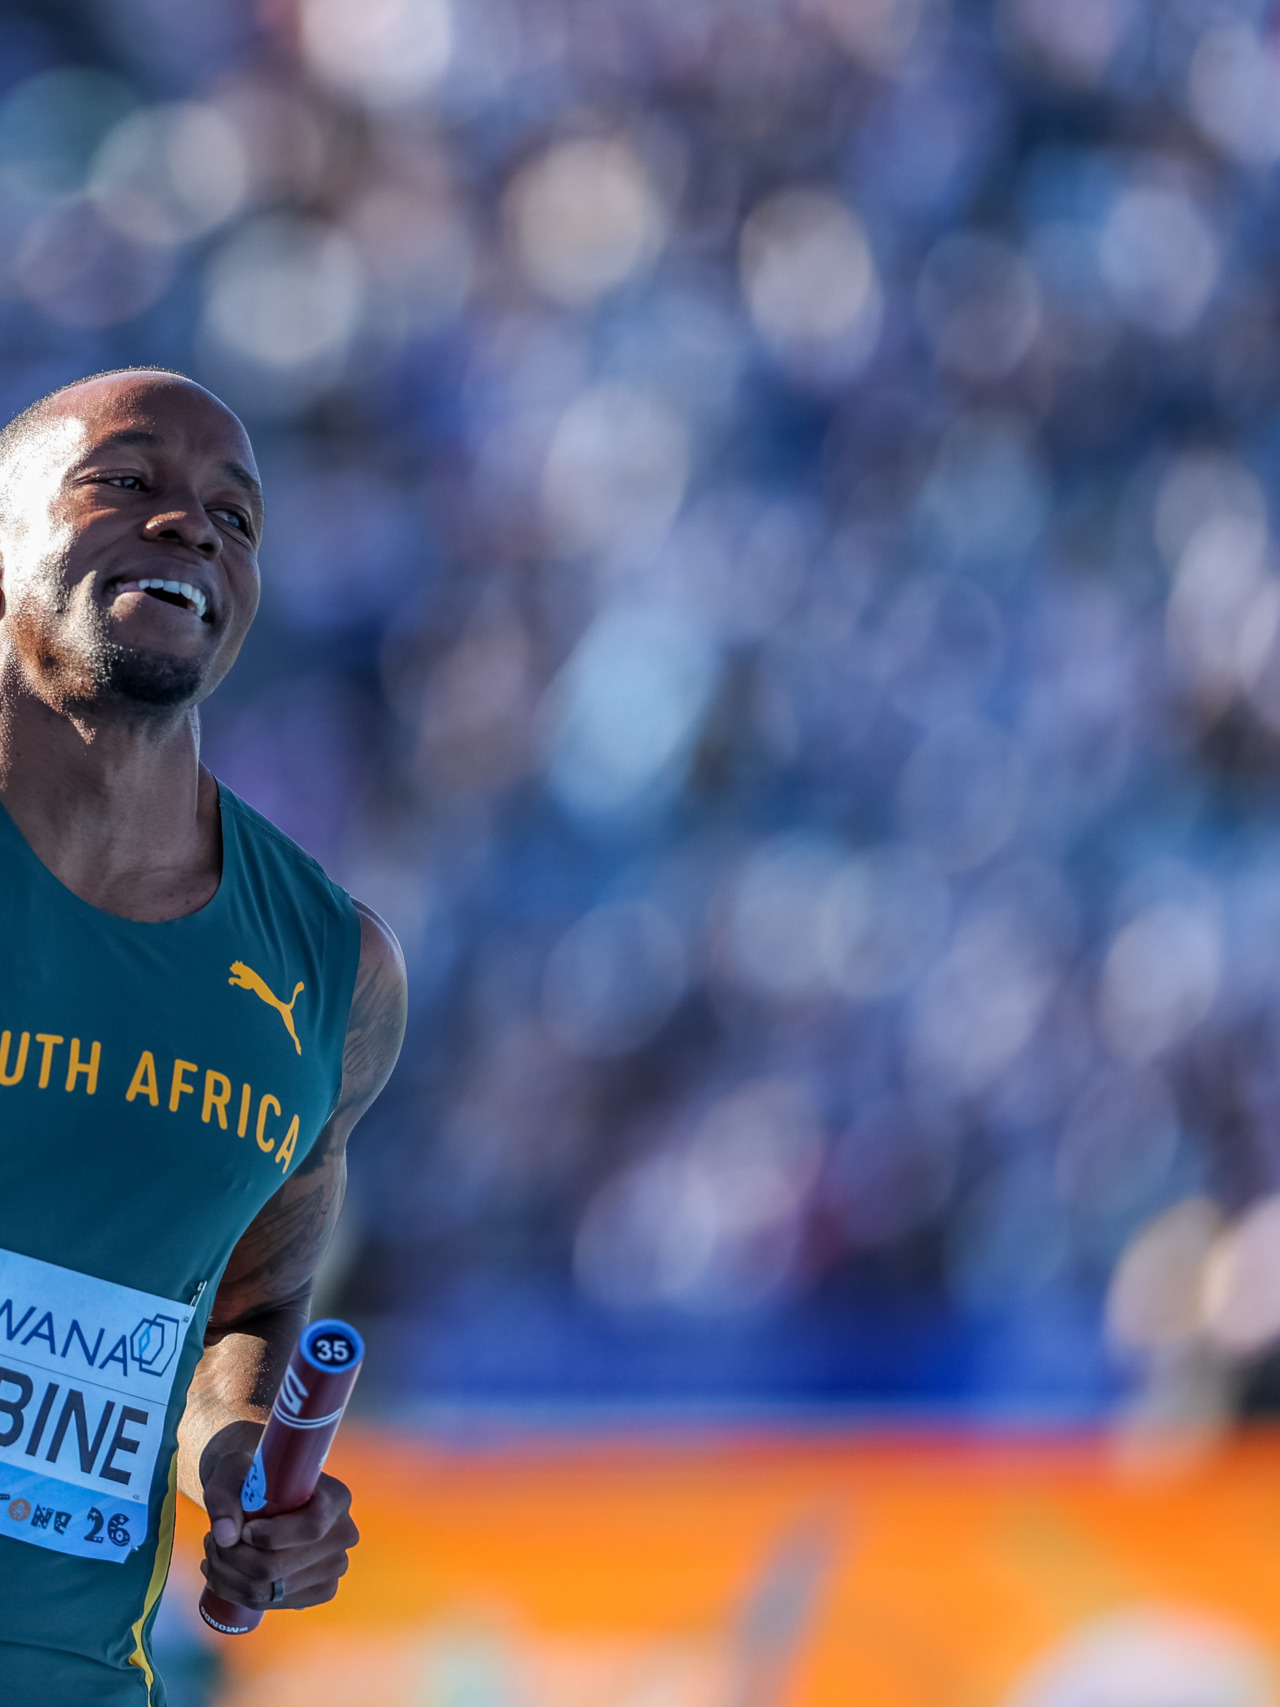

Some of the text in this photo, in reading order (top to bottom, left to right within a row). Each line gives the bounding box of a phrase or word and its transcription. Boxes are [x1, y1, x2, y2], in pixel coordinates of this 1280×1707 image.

[125, 1050, 300, 1174] AFRICA
[316, 1339, 349, 1362] 35
[83, 1507, 130, 1547] 26
[201, 1606, 239, 1633] MONDO
